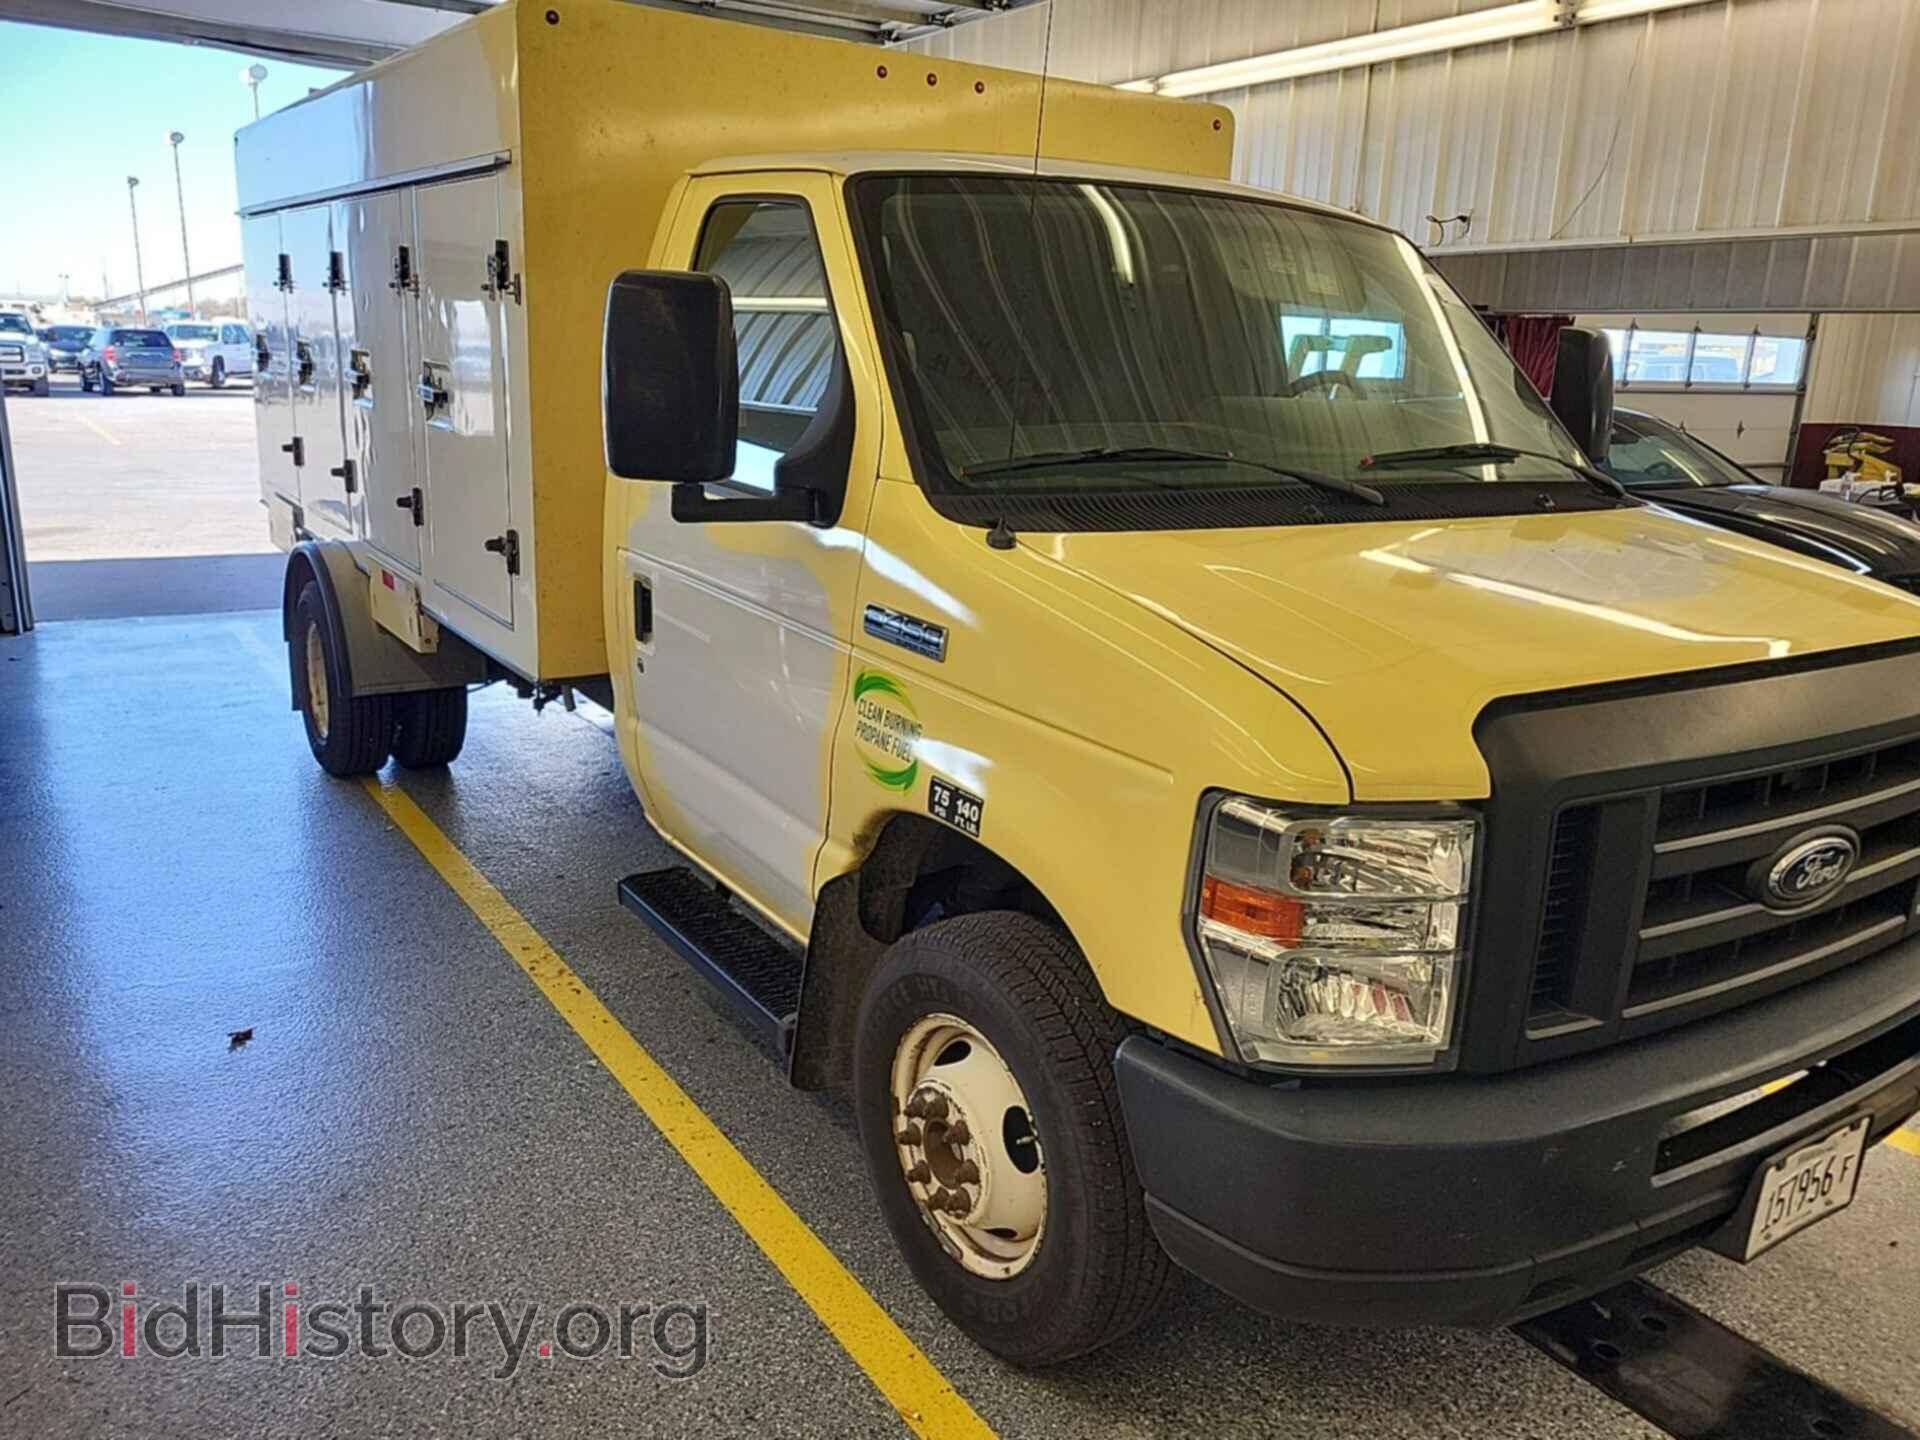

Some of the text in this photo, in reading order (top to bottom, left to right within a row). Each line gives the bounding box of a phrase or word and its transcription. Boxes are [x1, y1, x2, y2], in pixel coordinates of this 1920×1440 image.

[855, 720, 912, 763] PROPANE FUEL
[857, 698, 923, 742] CLEAN BURNING
[933, 785, 979, 822] 75 140
[1796, 850, 1845, 890] Ford
[1760, 1153, 1856, 1234] 157956 F
